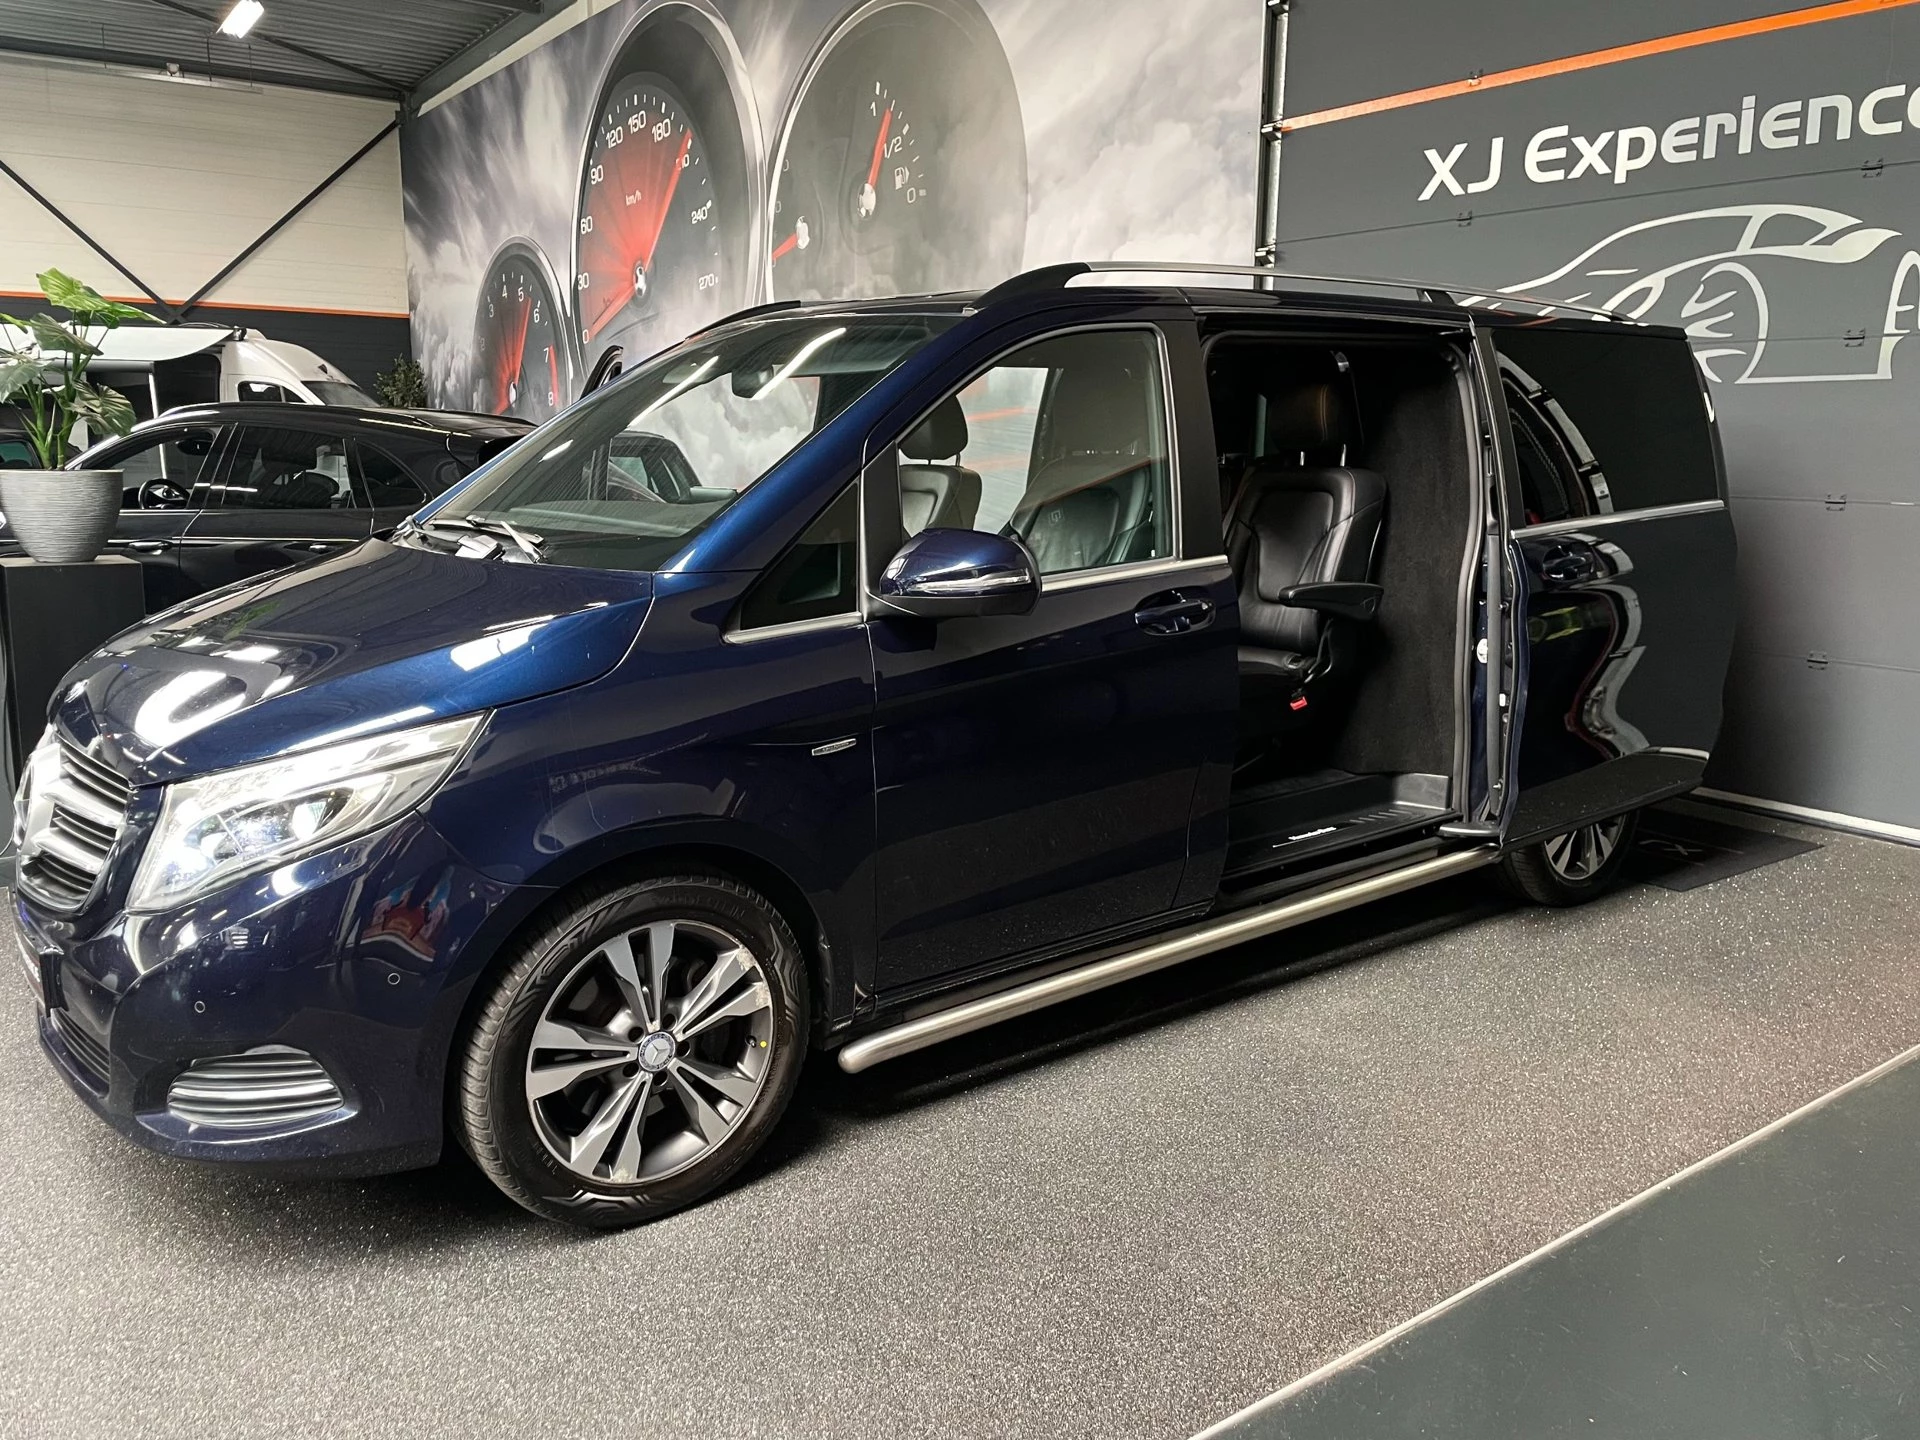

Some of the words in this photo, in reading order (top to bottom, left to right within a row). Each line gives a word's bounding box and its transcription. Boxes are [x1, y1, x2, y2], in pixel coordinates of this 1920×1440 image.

[870, 101, 876, 117] 1
[628, 110, 647, 135] 150
[652, 118, 671, 144] 180
[606, 126, 623, 149] 120
[591, 164, 604, 185] 90
[1417, 136, 1504, 201] XJ
[906, 187, 916, 204] 0
[691, 206, 708, 225] 240
[581, 216, 593, 235] 60
[578, 273, 589, 290] 30
[699, 273, 715, 290] 270
[502, 284, 508, 299] 4
[517, 286, 524, 302] 5
[488, 303, 495, 318] 3
[533, 308, 540, 323] 6
[582, 329, 590, 344] 0
[543, 347, 550, 363] 7
[547, 391, 554, 406] 8
